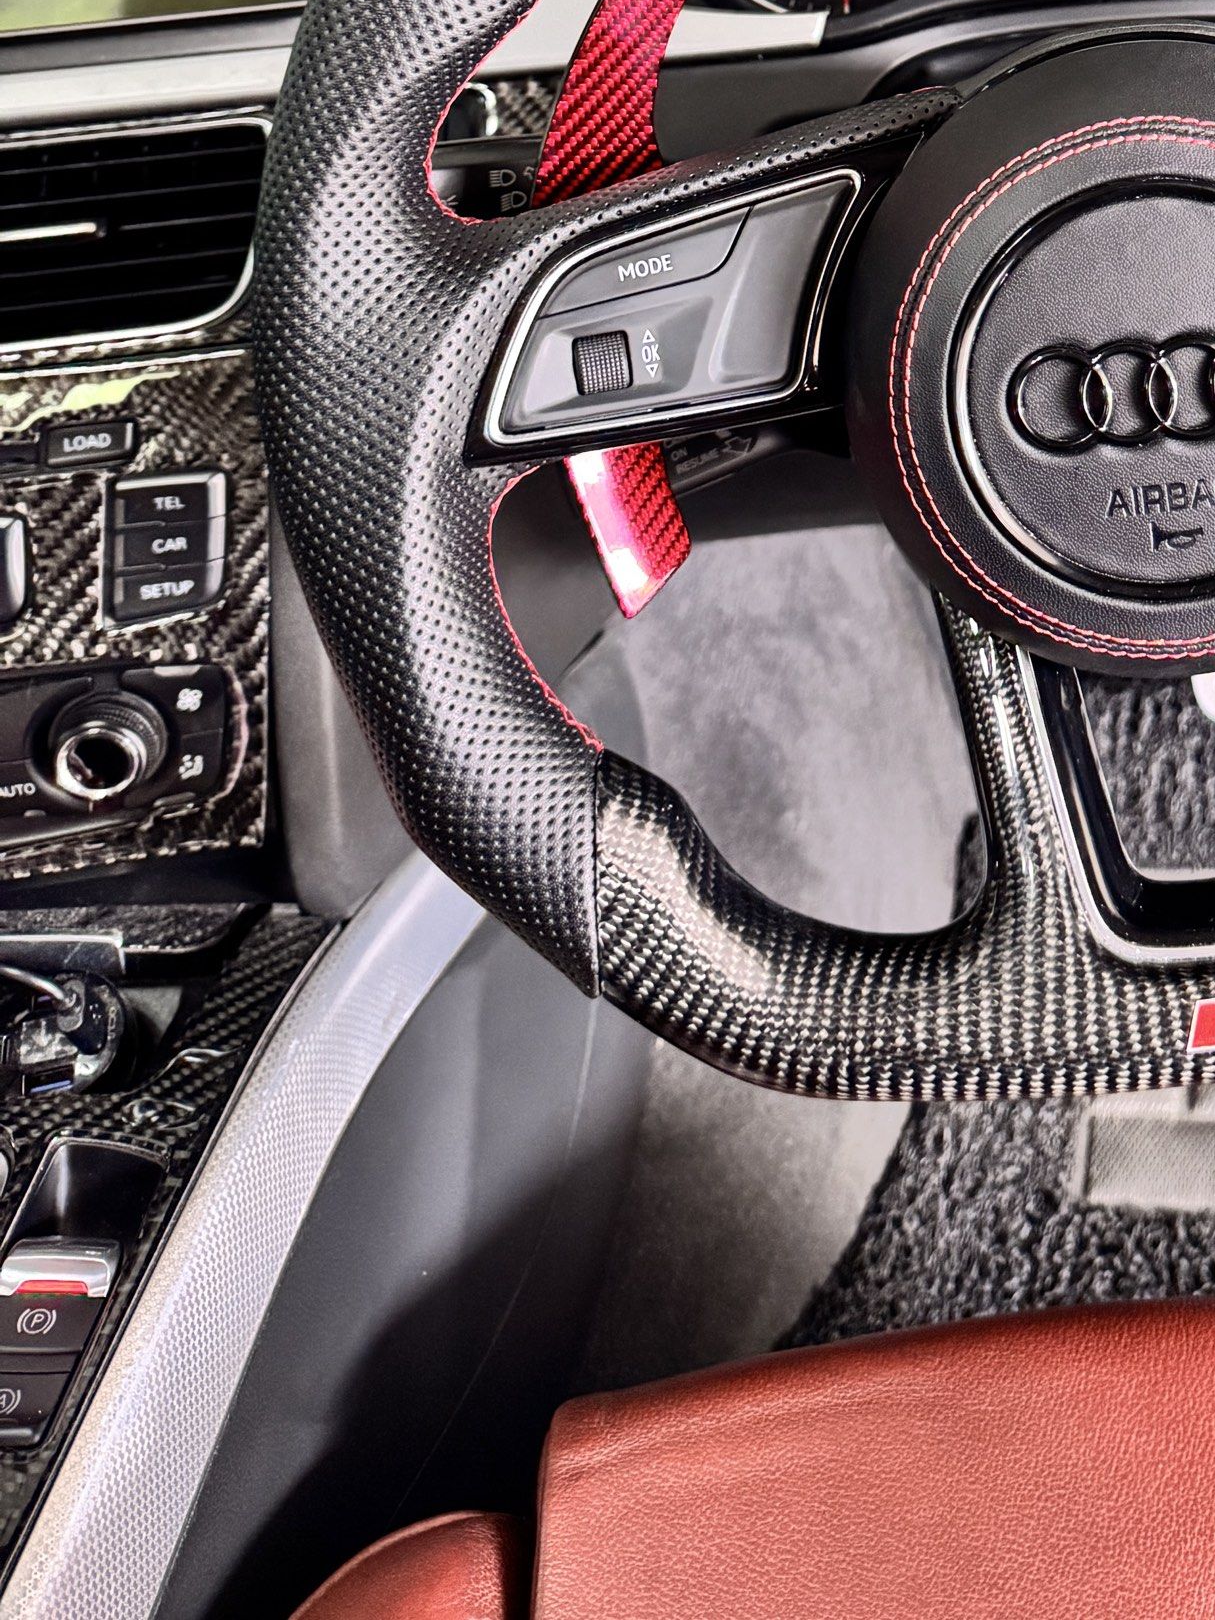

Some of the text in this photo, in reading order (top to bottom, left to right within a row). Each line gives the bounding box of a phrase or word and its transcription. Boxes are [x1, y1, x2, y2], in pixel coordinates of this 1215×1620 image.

[617, 253, 674, 282] MODE
[641, 343, 661, 363] OK
[62, 432, 112, 453] LOAD
[153, 495, 186, 511] TEL
[151, 536, 189, 554] CAR
[139, 579, 196, 601] SETUP
